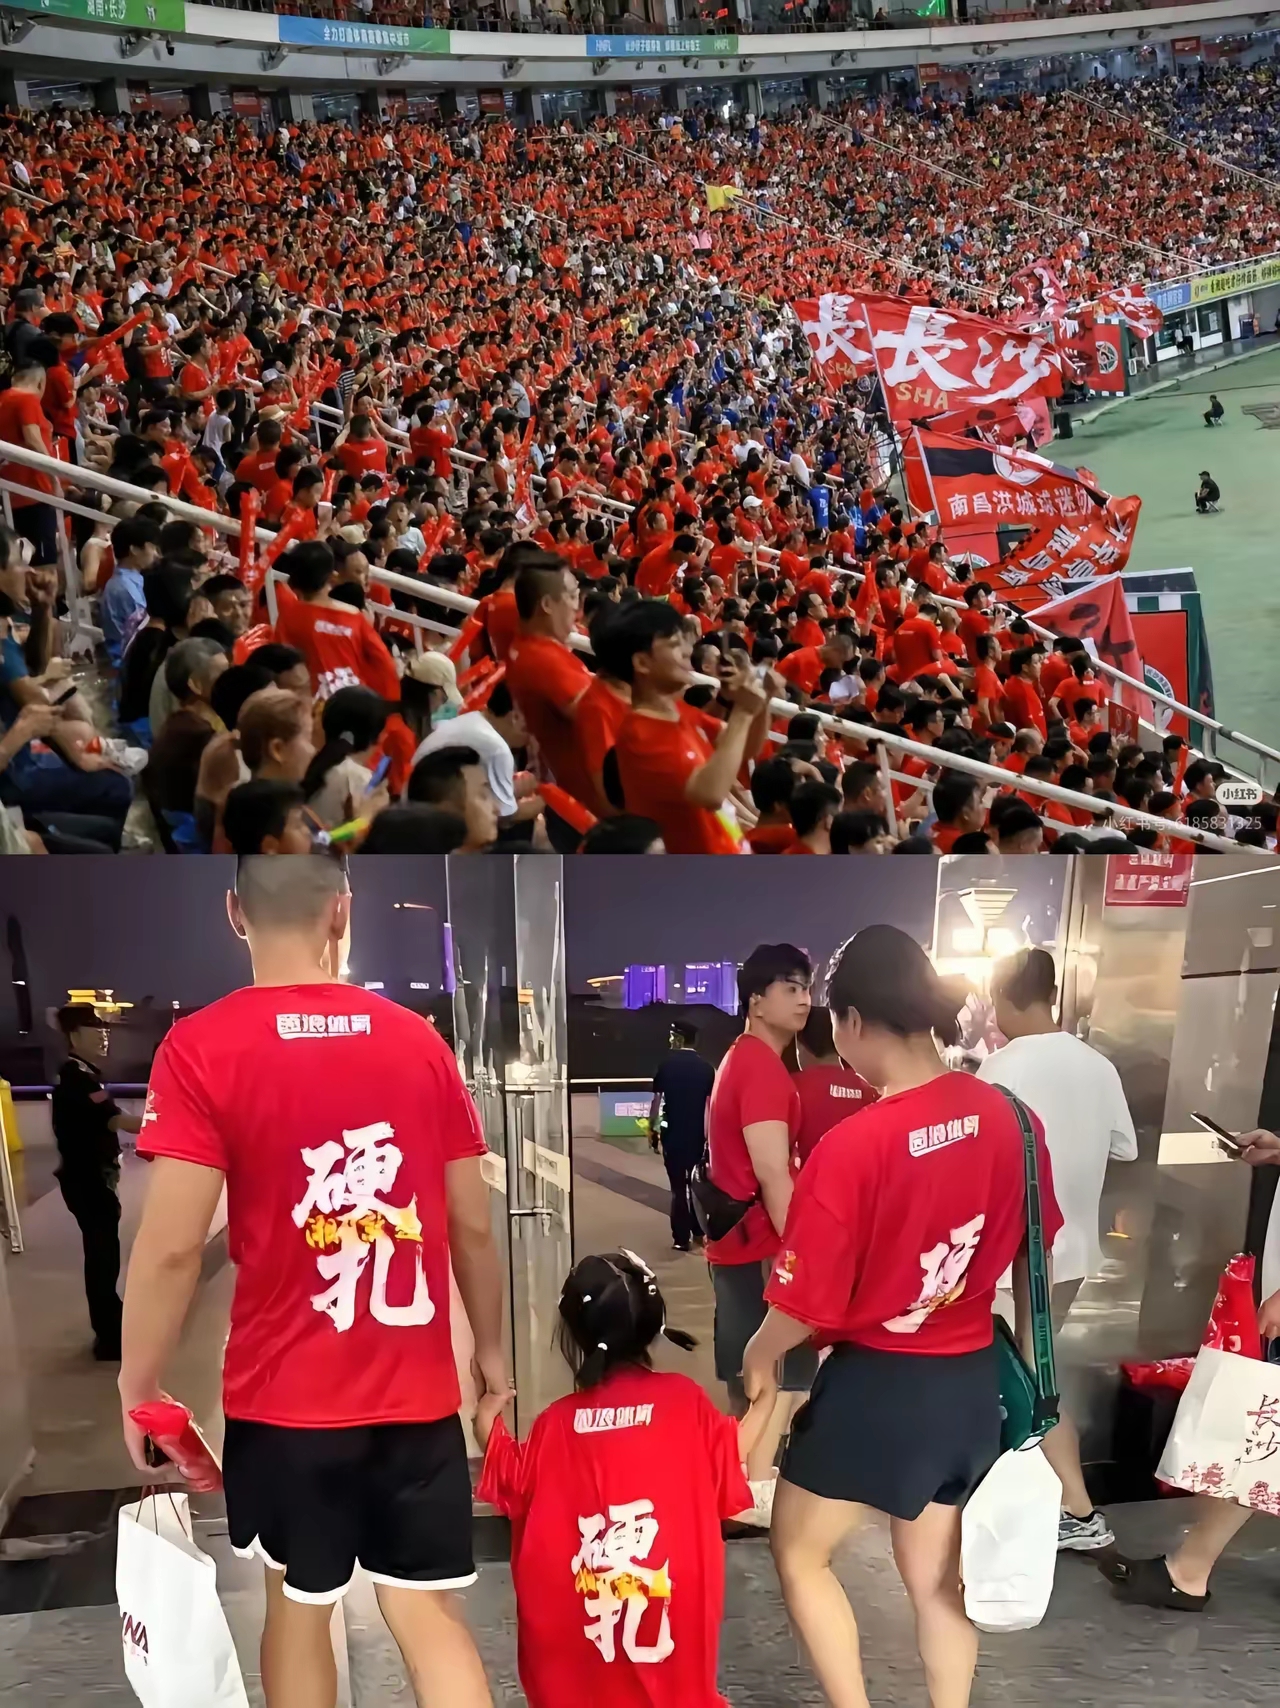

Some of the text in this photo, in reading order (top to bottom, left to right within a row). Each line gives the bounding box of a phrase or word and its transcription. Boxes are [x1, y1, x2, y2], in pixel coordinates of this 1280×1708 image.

[895, 381, 951, 411] SHA
[947, 484, 1109, 520] 南昌洪城球迷协
